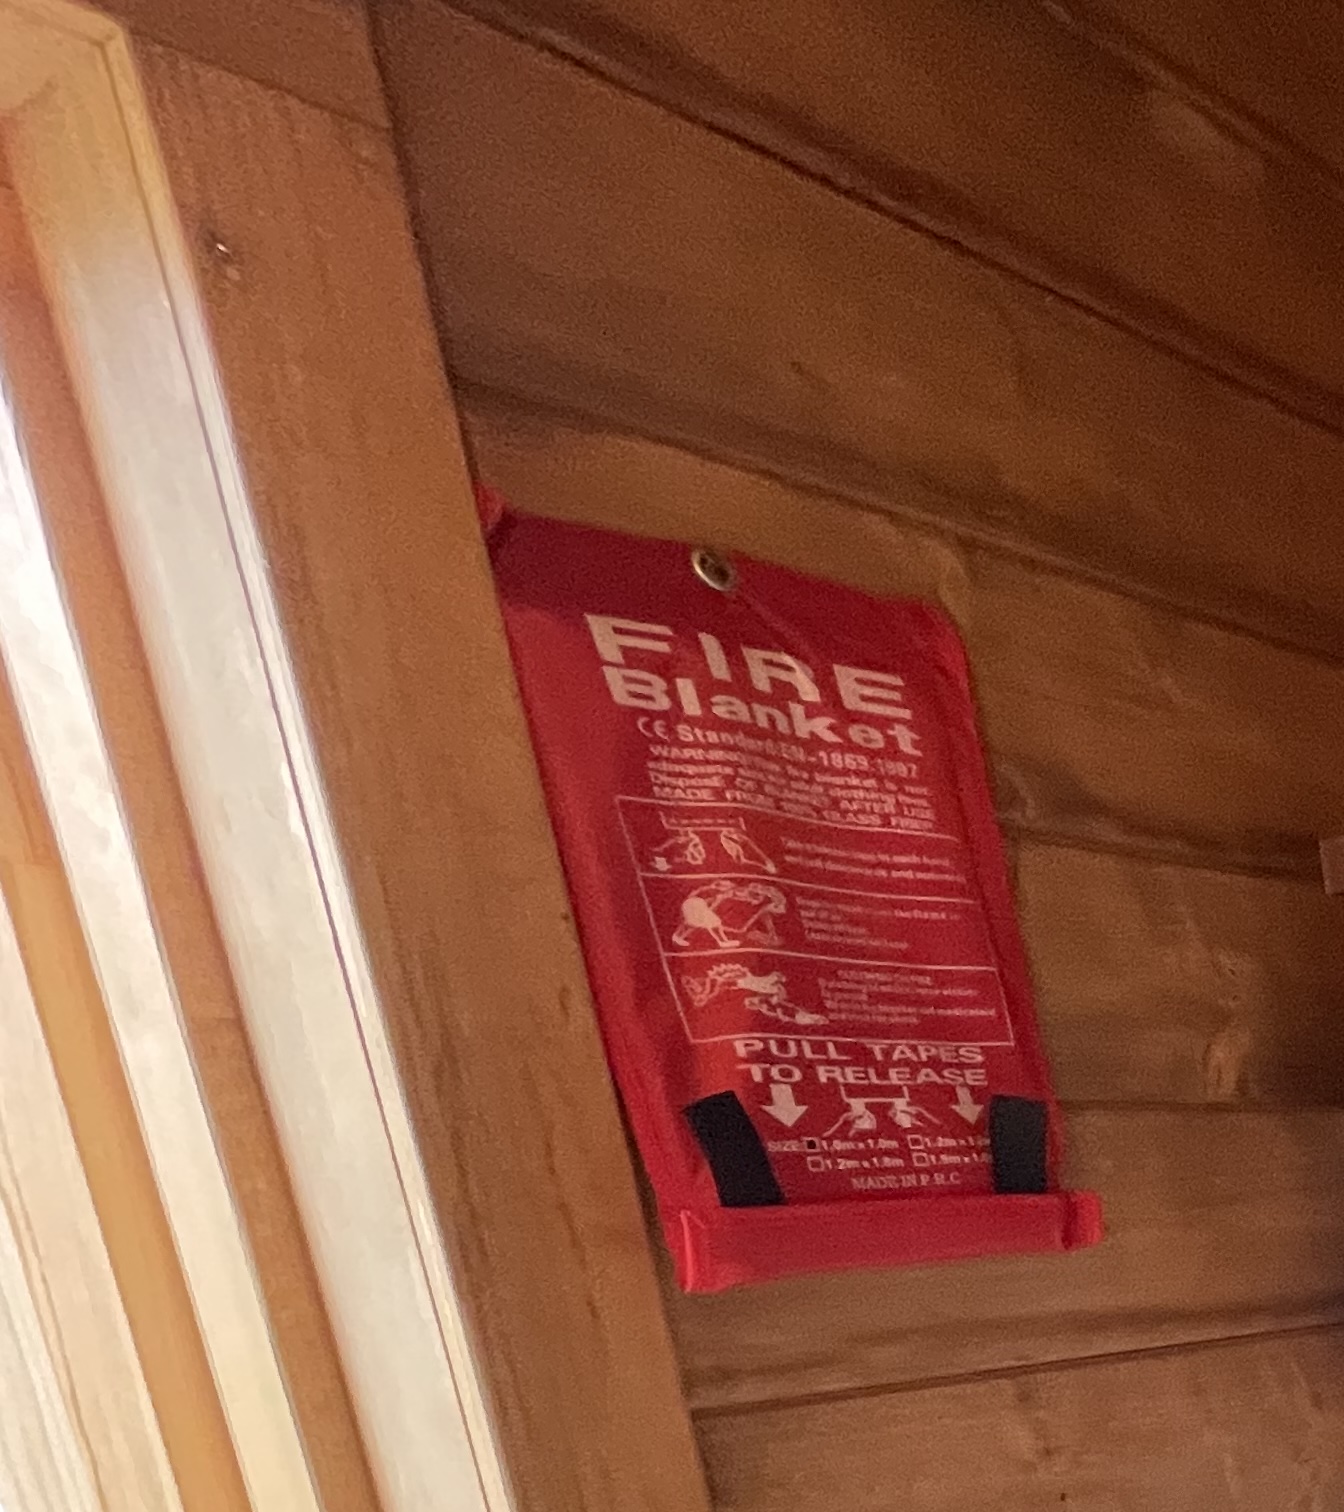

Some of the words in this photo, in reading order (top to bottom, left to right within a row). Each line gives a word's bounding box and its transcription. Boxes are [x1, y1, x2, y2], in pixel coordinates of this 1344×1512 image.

[585, 613, 913, 720] FIRE
[602, 665, 923, 757] Blanket
[734, 1038, 852, 1060] PULL
[865, 1043, 985, 1064] TAPES
[736, 1062, 803, 1083] TO
[816, 1064, 988, 1086] RELEASE
[851, 1174, 900, 1190] MADE
[901, 1173, 917, 1188] IN
